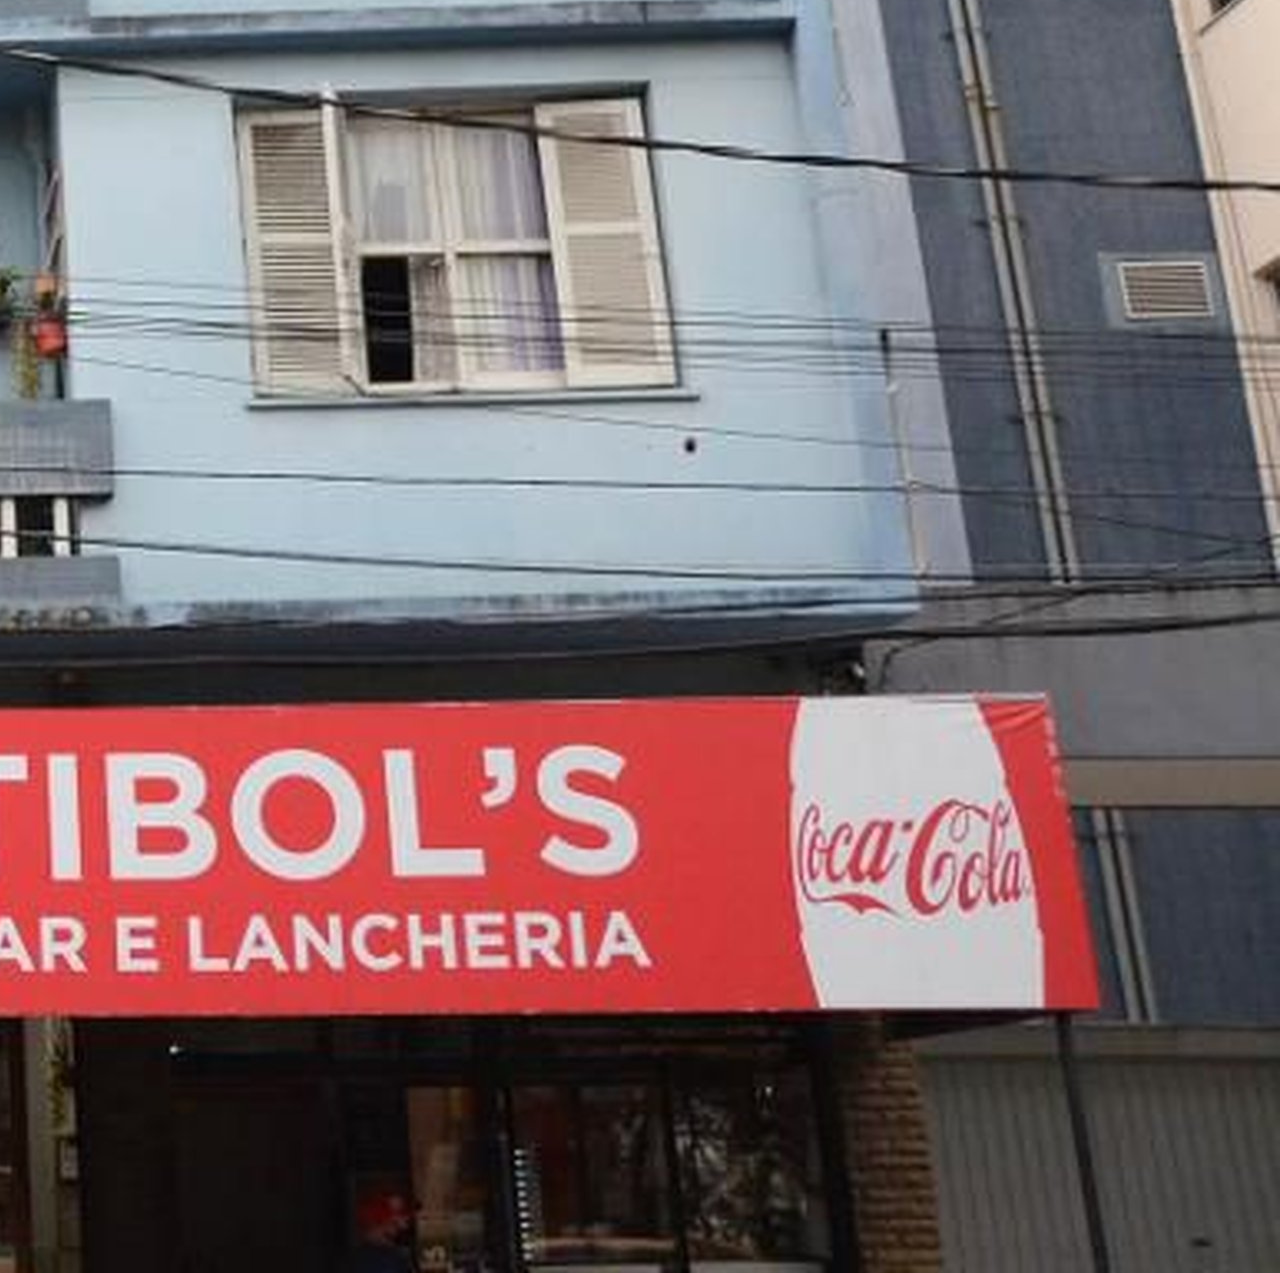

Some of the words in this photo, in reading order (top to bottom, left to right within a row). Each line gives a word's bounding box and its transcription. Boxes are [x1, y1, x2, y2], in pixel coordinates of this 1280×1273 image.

[799, 799, 1026, 915] Coca-Cola
[116, 916, 159, 972] E
[188, 911, 652, 972] LANCHERIA
